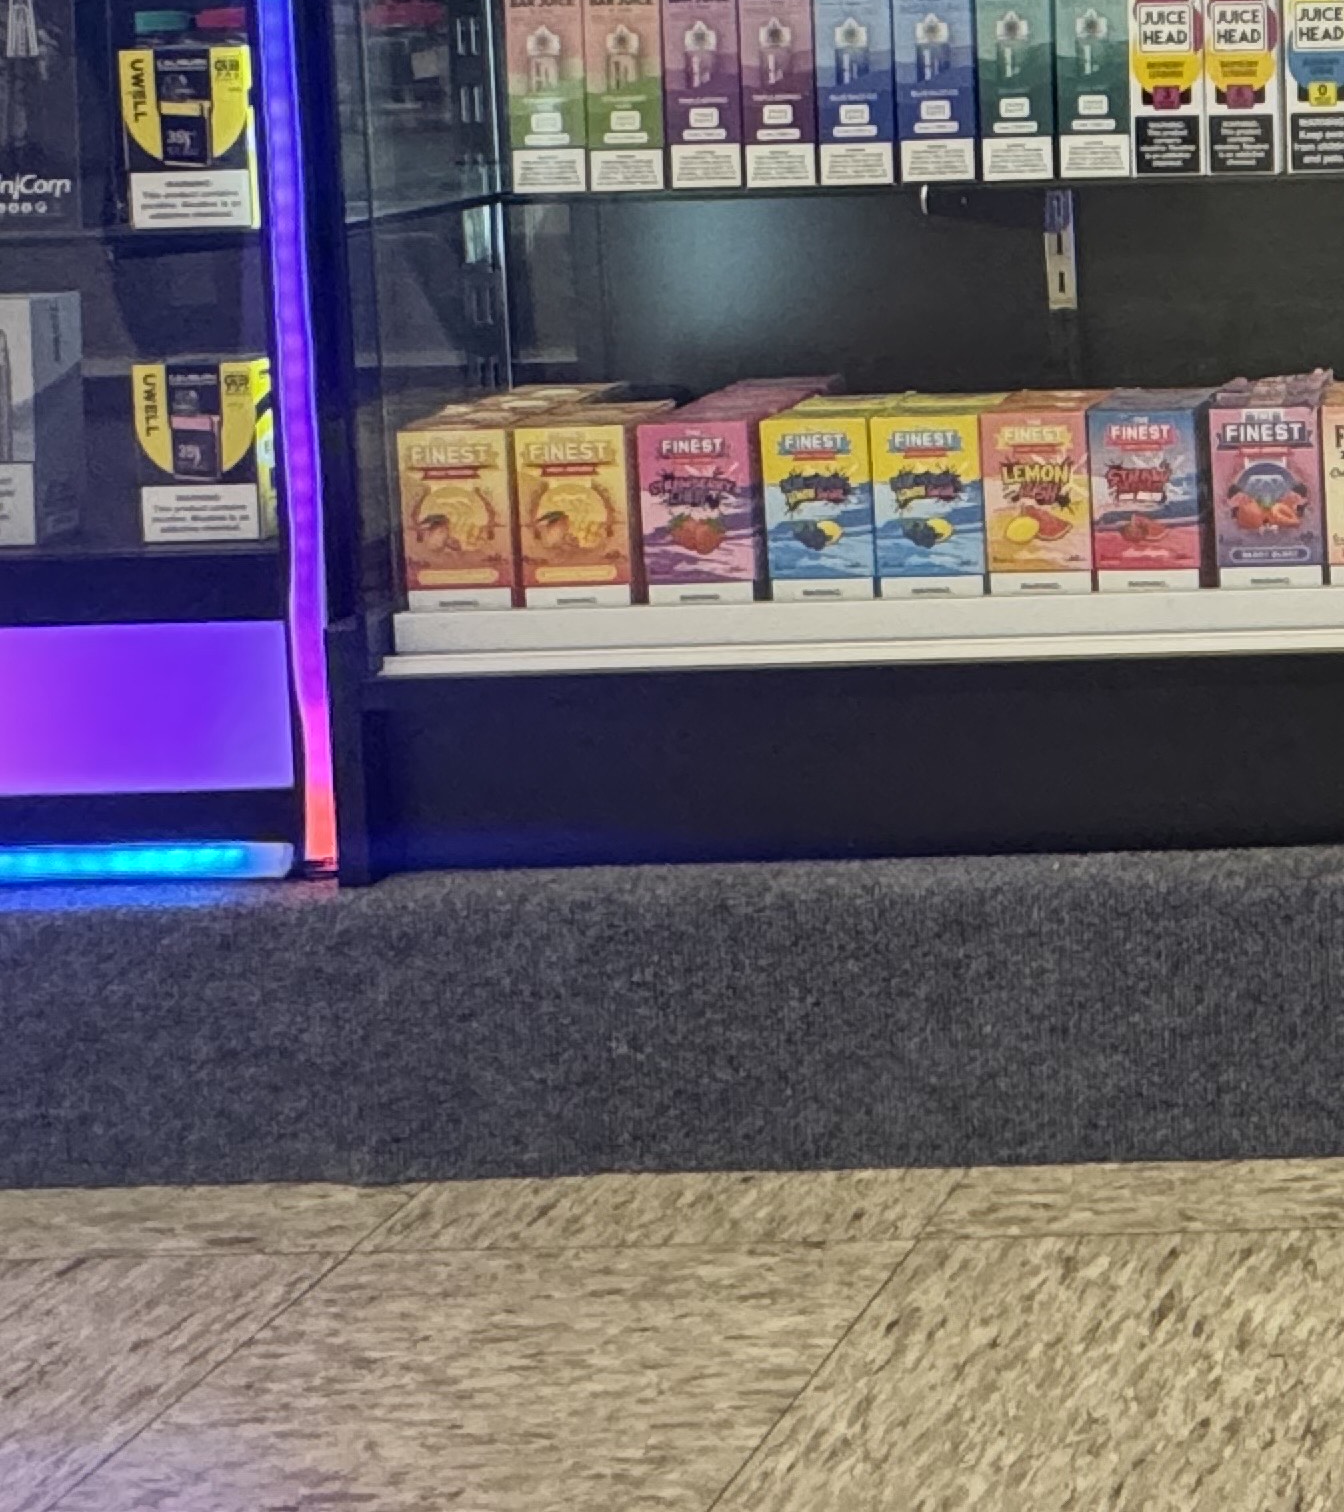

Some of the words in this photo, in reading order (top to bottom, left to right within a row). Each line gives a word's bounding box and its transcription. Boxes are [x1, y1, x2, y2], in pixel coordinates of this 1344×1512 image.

[1141, 9, 1187, 26] JUICE
[1214, 9, 1260, 25] JUICE
[1297, 6, 1344, 24] JUICE
[1142, 28, 1188, 46] HEAD
[1216, 28, 1261, 45] HEAD
[1298, 23, 1344, 42] HEAD
[130, 58, 148, 124] UWELL
[142, 374, 159, 437] UWELL
[892, 431, 955, 449] FINEST
[1004, 427, 1064, 443] FINEST
[1109, 424, 1171, 441] FINEST
[1224, 423, 1302, 442] FINEST
[661, 437, 724, 456] FINEST
[783, 434, 844, 451] FINEST
[409, 445, 489, 465] FINEST
[527, 443, 608, 463] FINEST
[1001, 463, 1070, 483] LEMON
